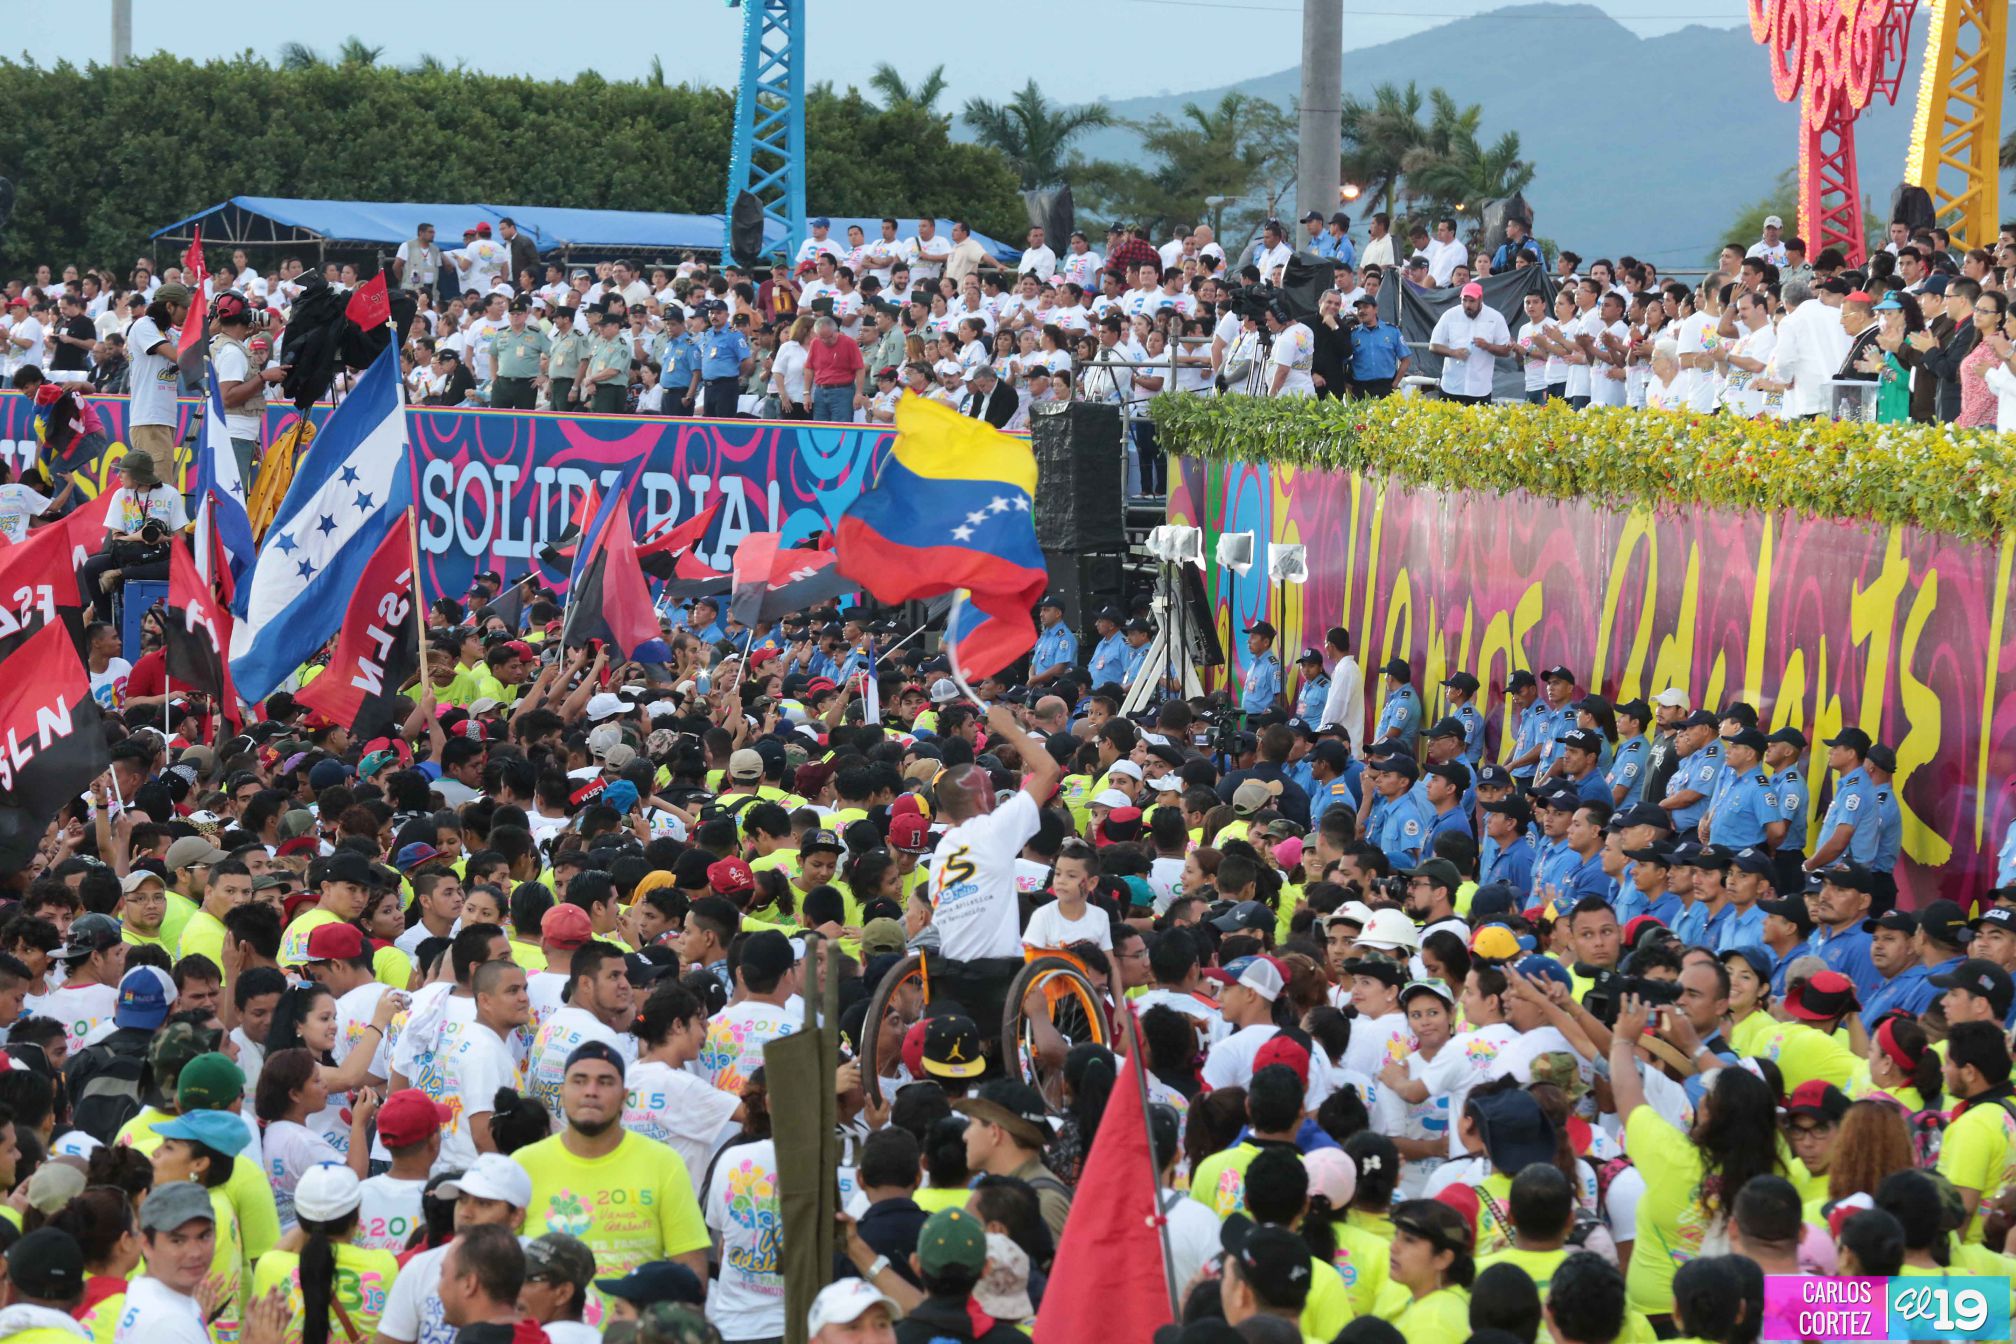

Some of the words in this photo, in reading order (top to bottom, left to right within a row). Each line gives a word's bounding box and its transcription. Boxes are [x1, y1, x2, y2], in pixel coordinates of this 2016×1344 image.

[743, 1020, 792, 1037] 2015
[625, 1091, 667, 1110] 015
[597, 1188, 653, 1206] 2015
